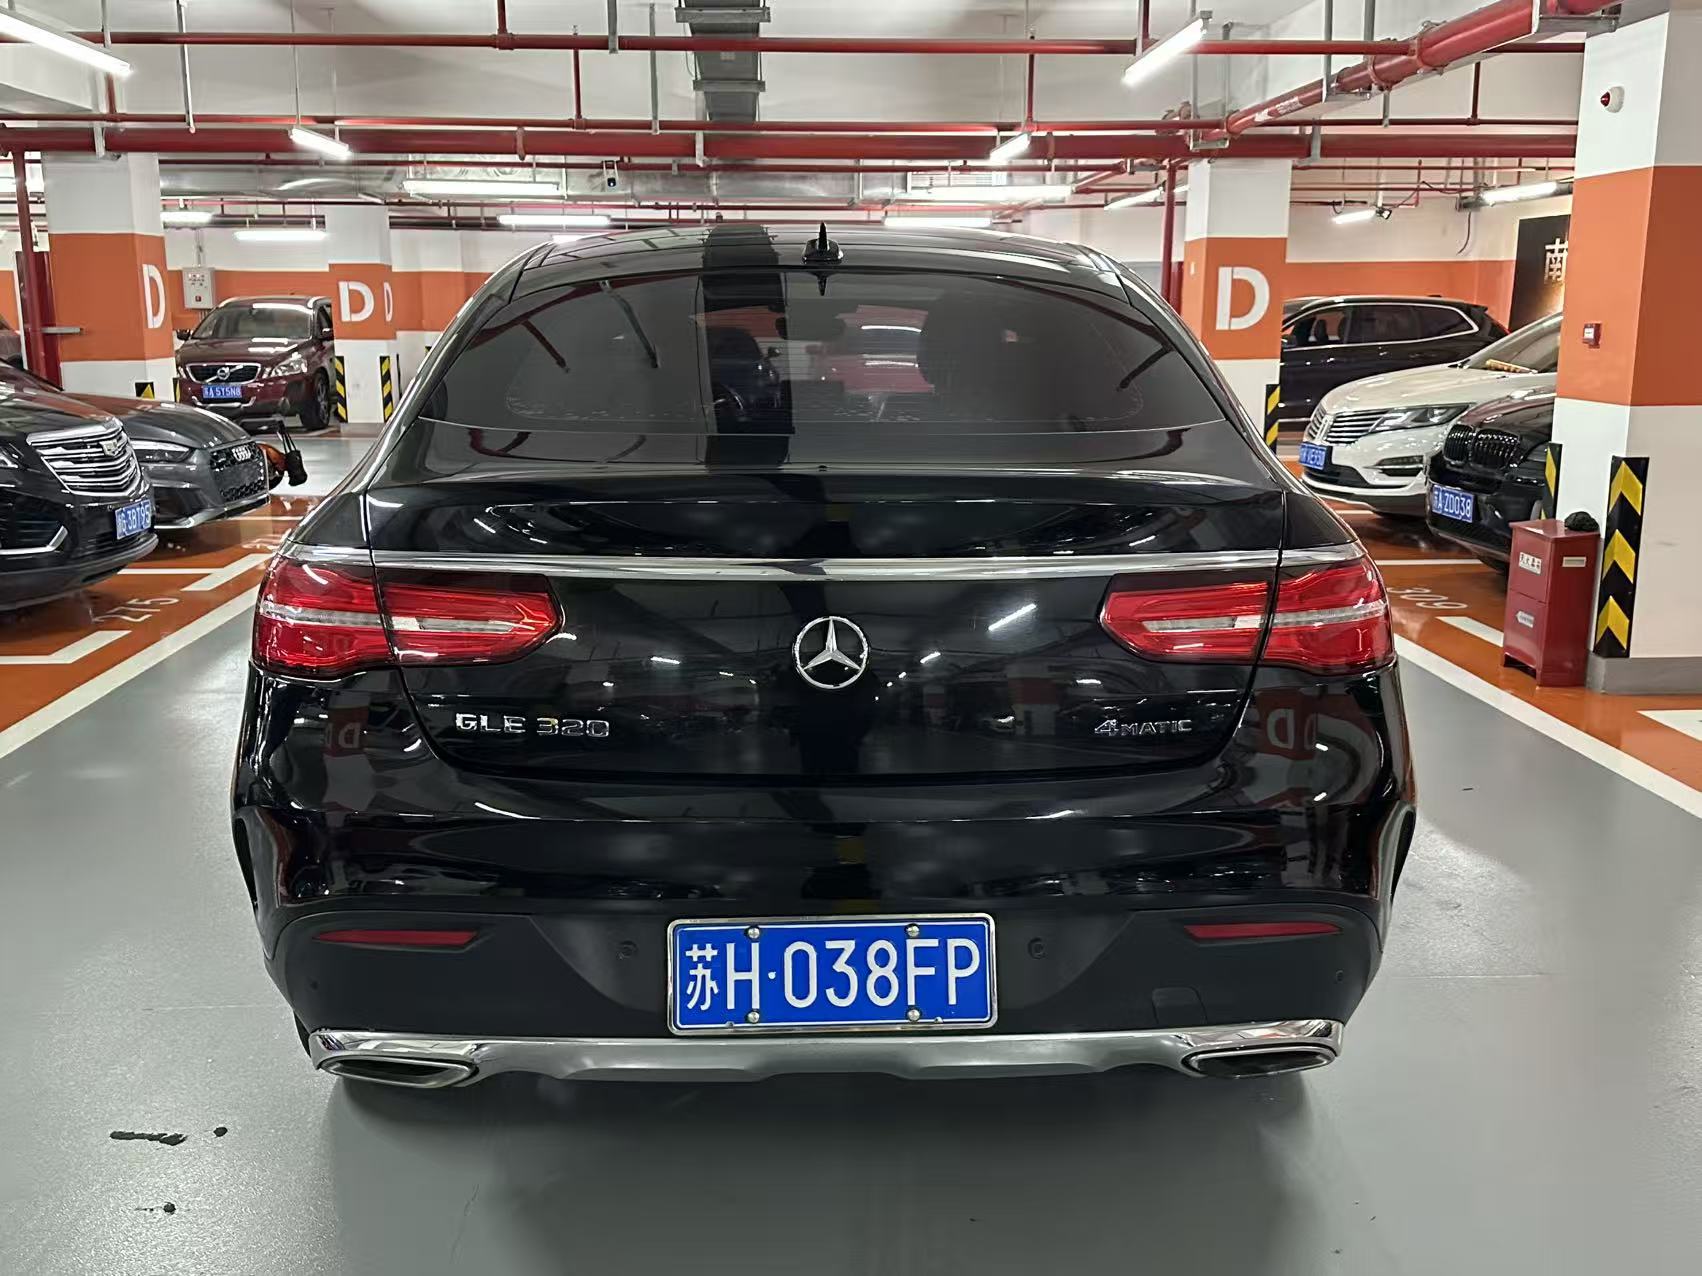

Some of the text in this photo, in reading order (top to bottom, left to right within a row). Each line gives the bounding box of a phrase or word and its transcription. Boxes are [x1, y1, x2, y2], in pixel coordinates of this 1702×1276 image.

[142, 263, 166, 329] D
[338, 281, 375, 322] D
[384, 281, 393, 322] D
[1216, 266, 1270, 331] D
[455, 713, 610, 738] GLE 320
[1094, 719, 1193, 737] 4MATIC
[685, 938, 981, 1012] 苏H·038FP
